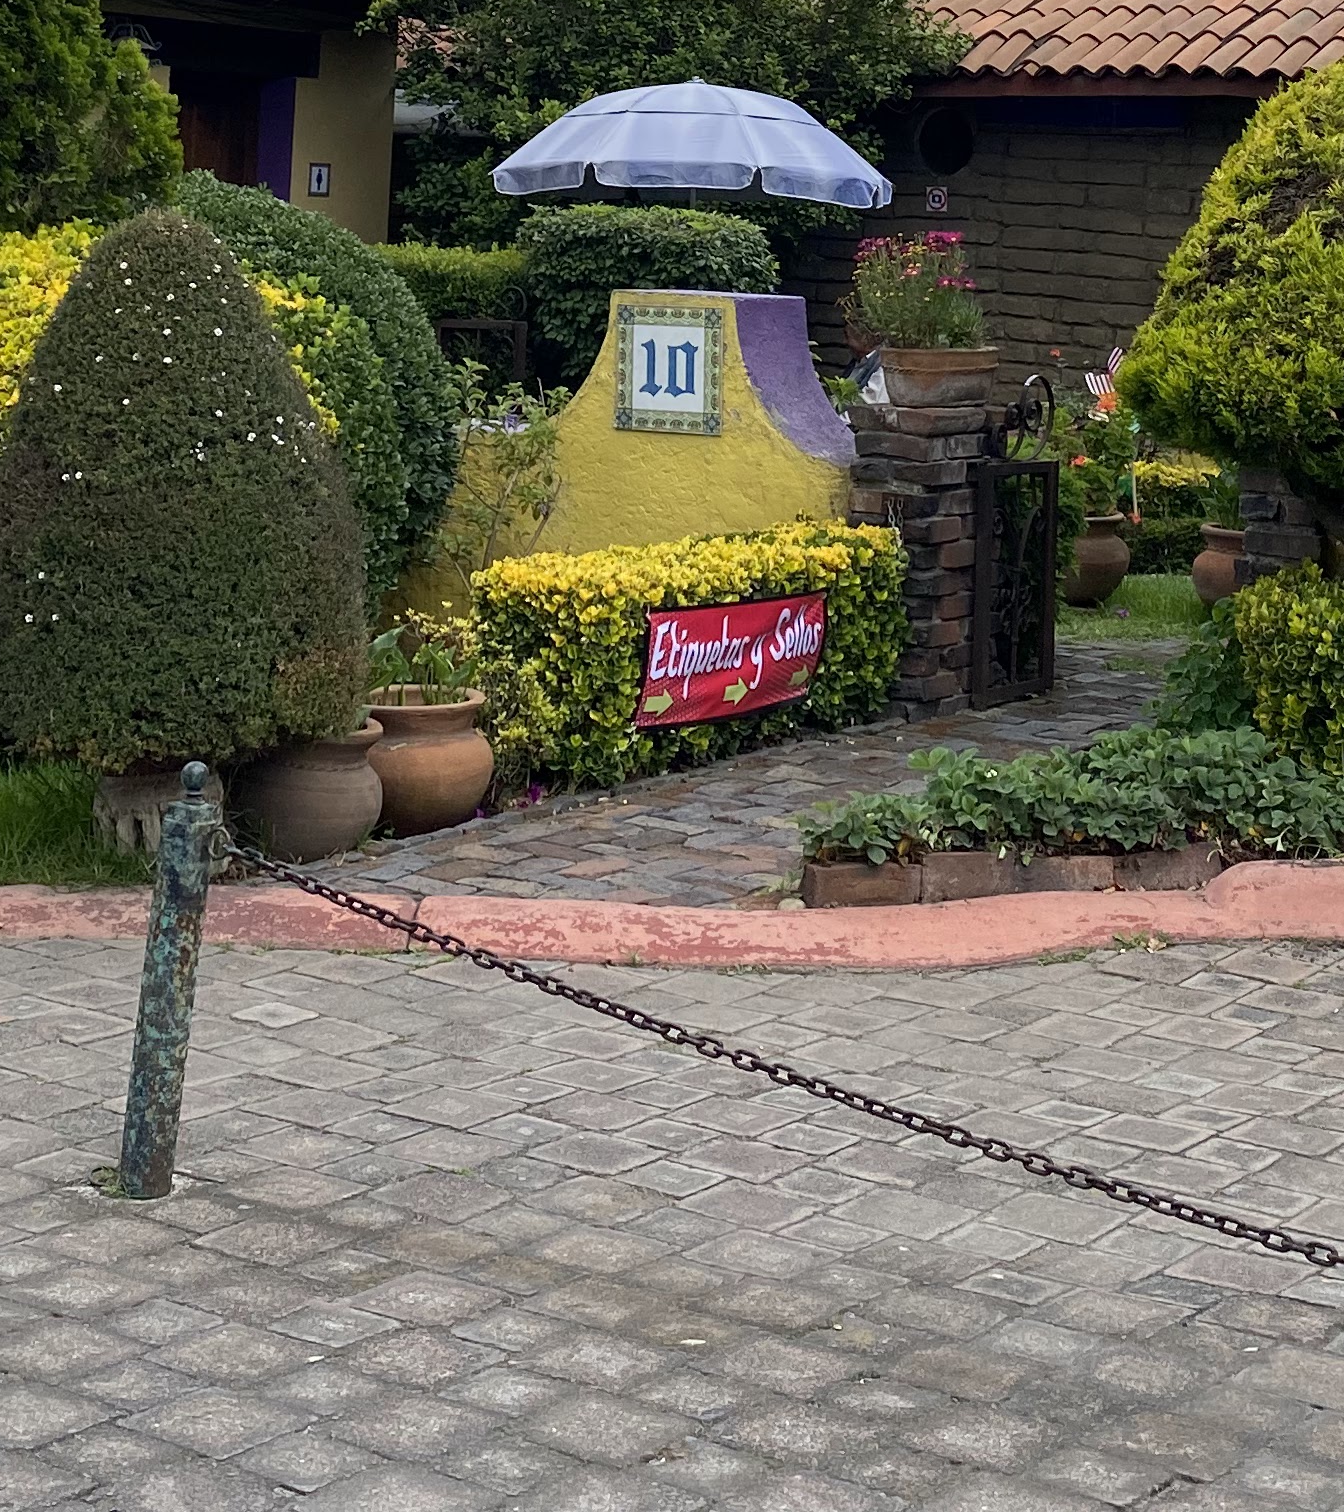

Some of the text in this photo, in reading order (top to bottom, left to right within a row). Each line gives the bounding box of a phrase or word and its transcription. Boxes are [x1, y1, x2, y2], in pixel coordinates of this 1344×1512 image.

[639, 338, 700, 398] 10
[649, 603, 823, 700] Etiquetas y Sellos
